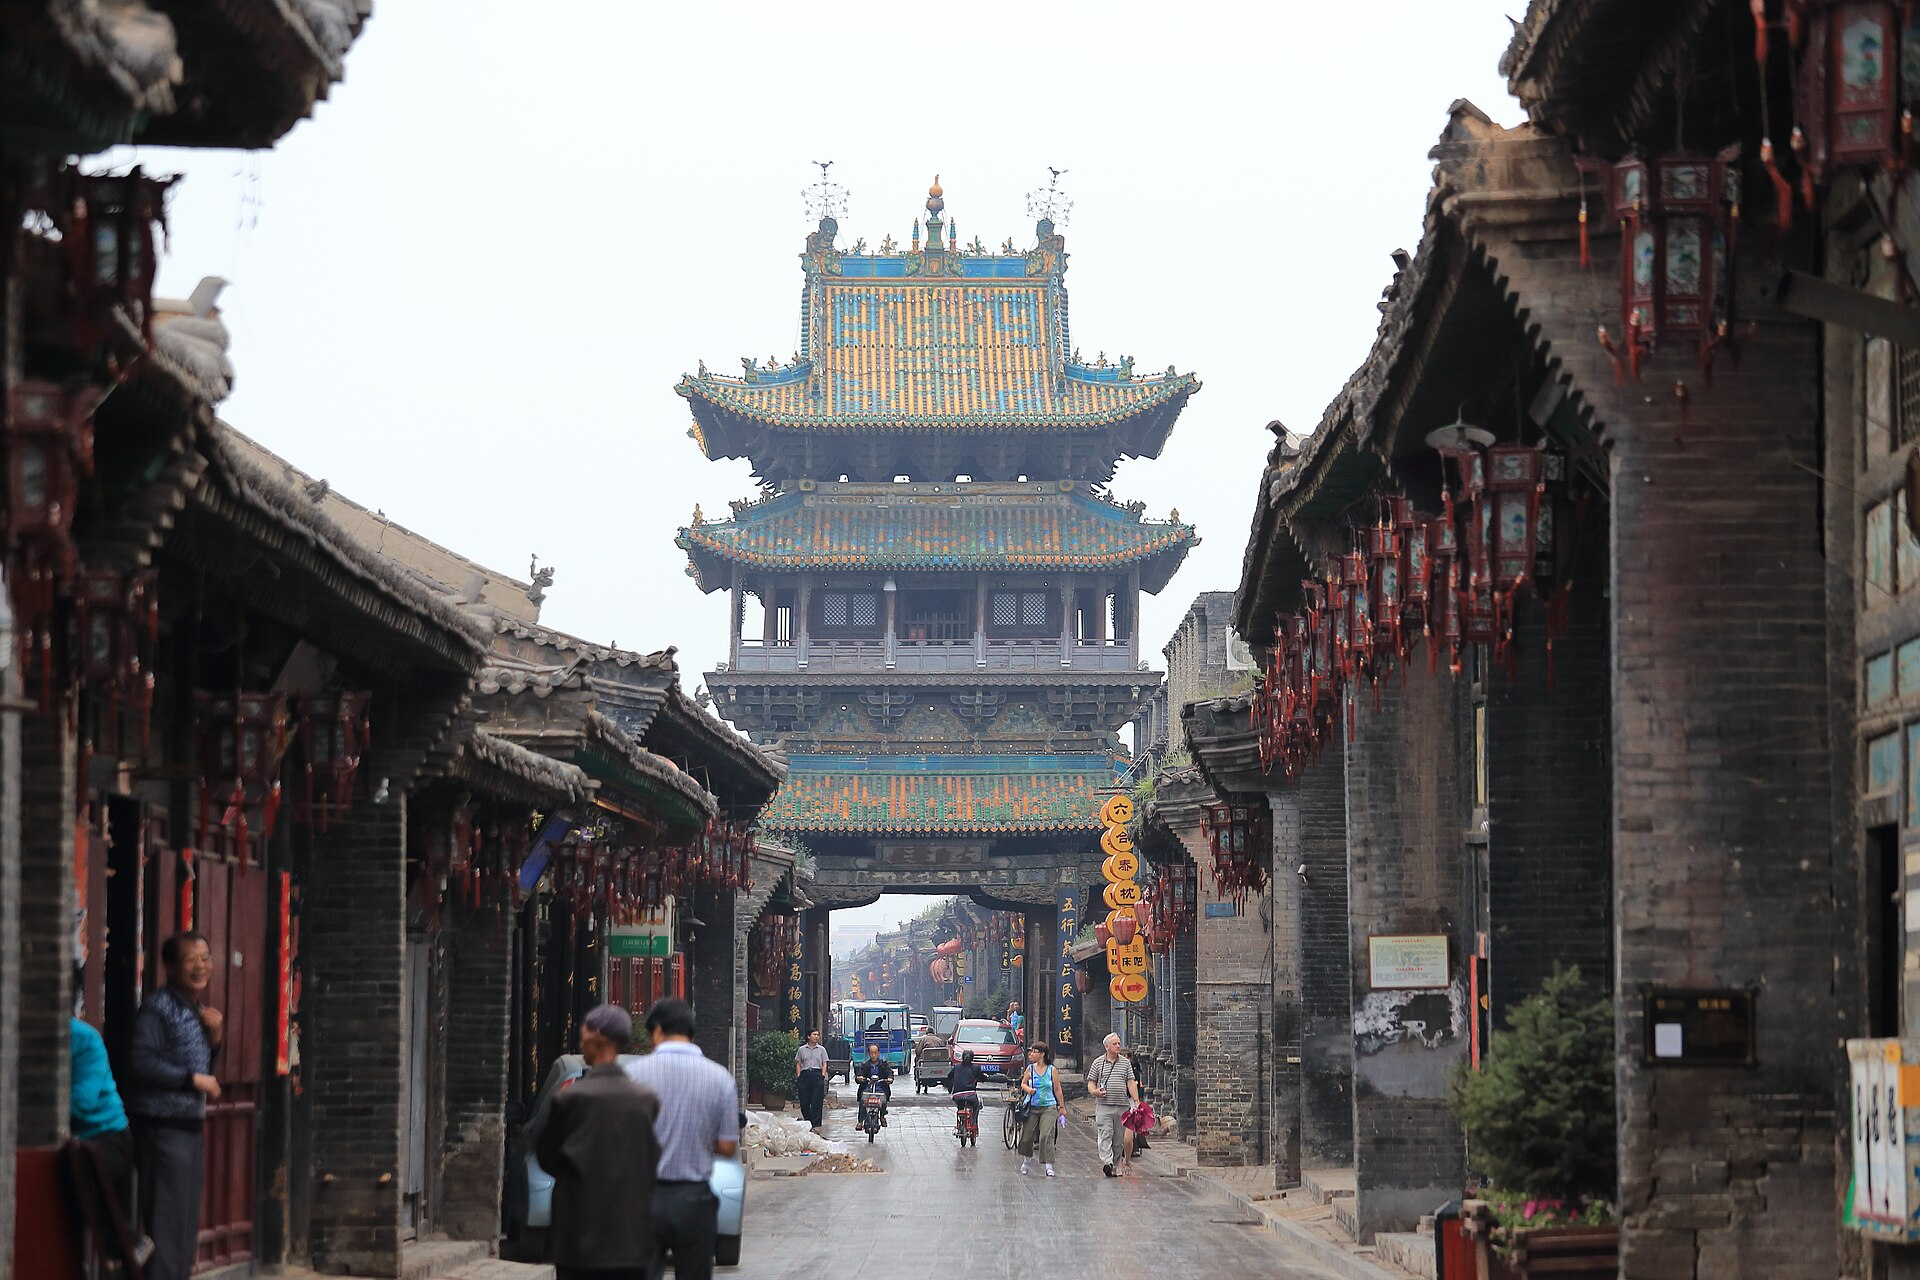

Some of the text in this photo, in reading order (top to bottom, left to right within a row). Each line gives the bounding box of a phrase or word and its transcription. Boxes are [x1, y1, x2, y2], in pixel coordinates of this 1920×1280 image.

[1114, 803, 1135, 919] 六合泰枕
[1122, 956, 1143, 967] 床吧
